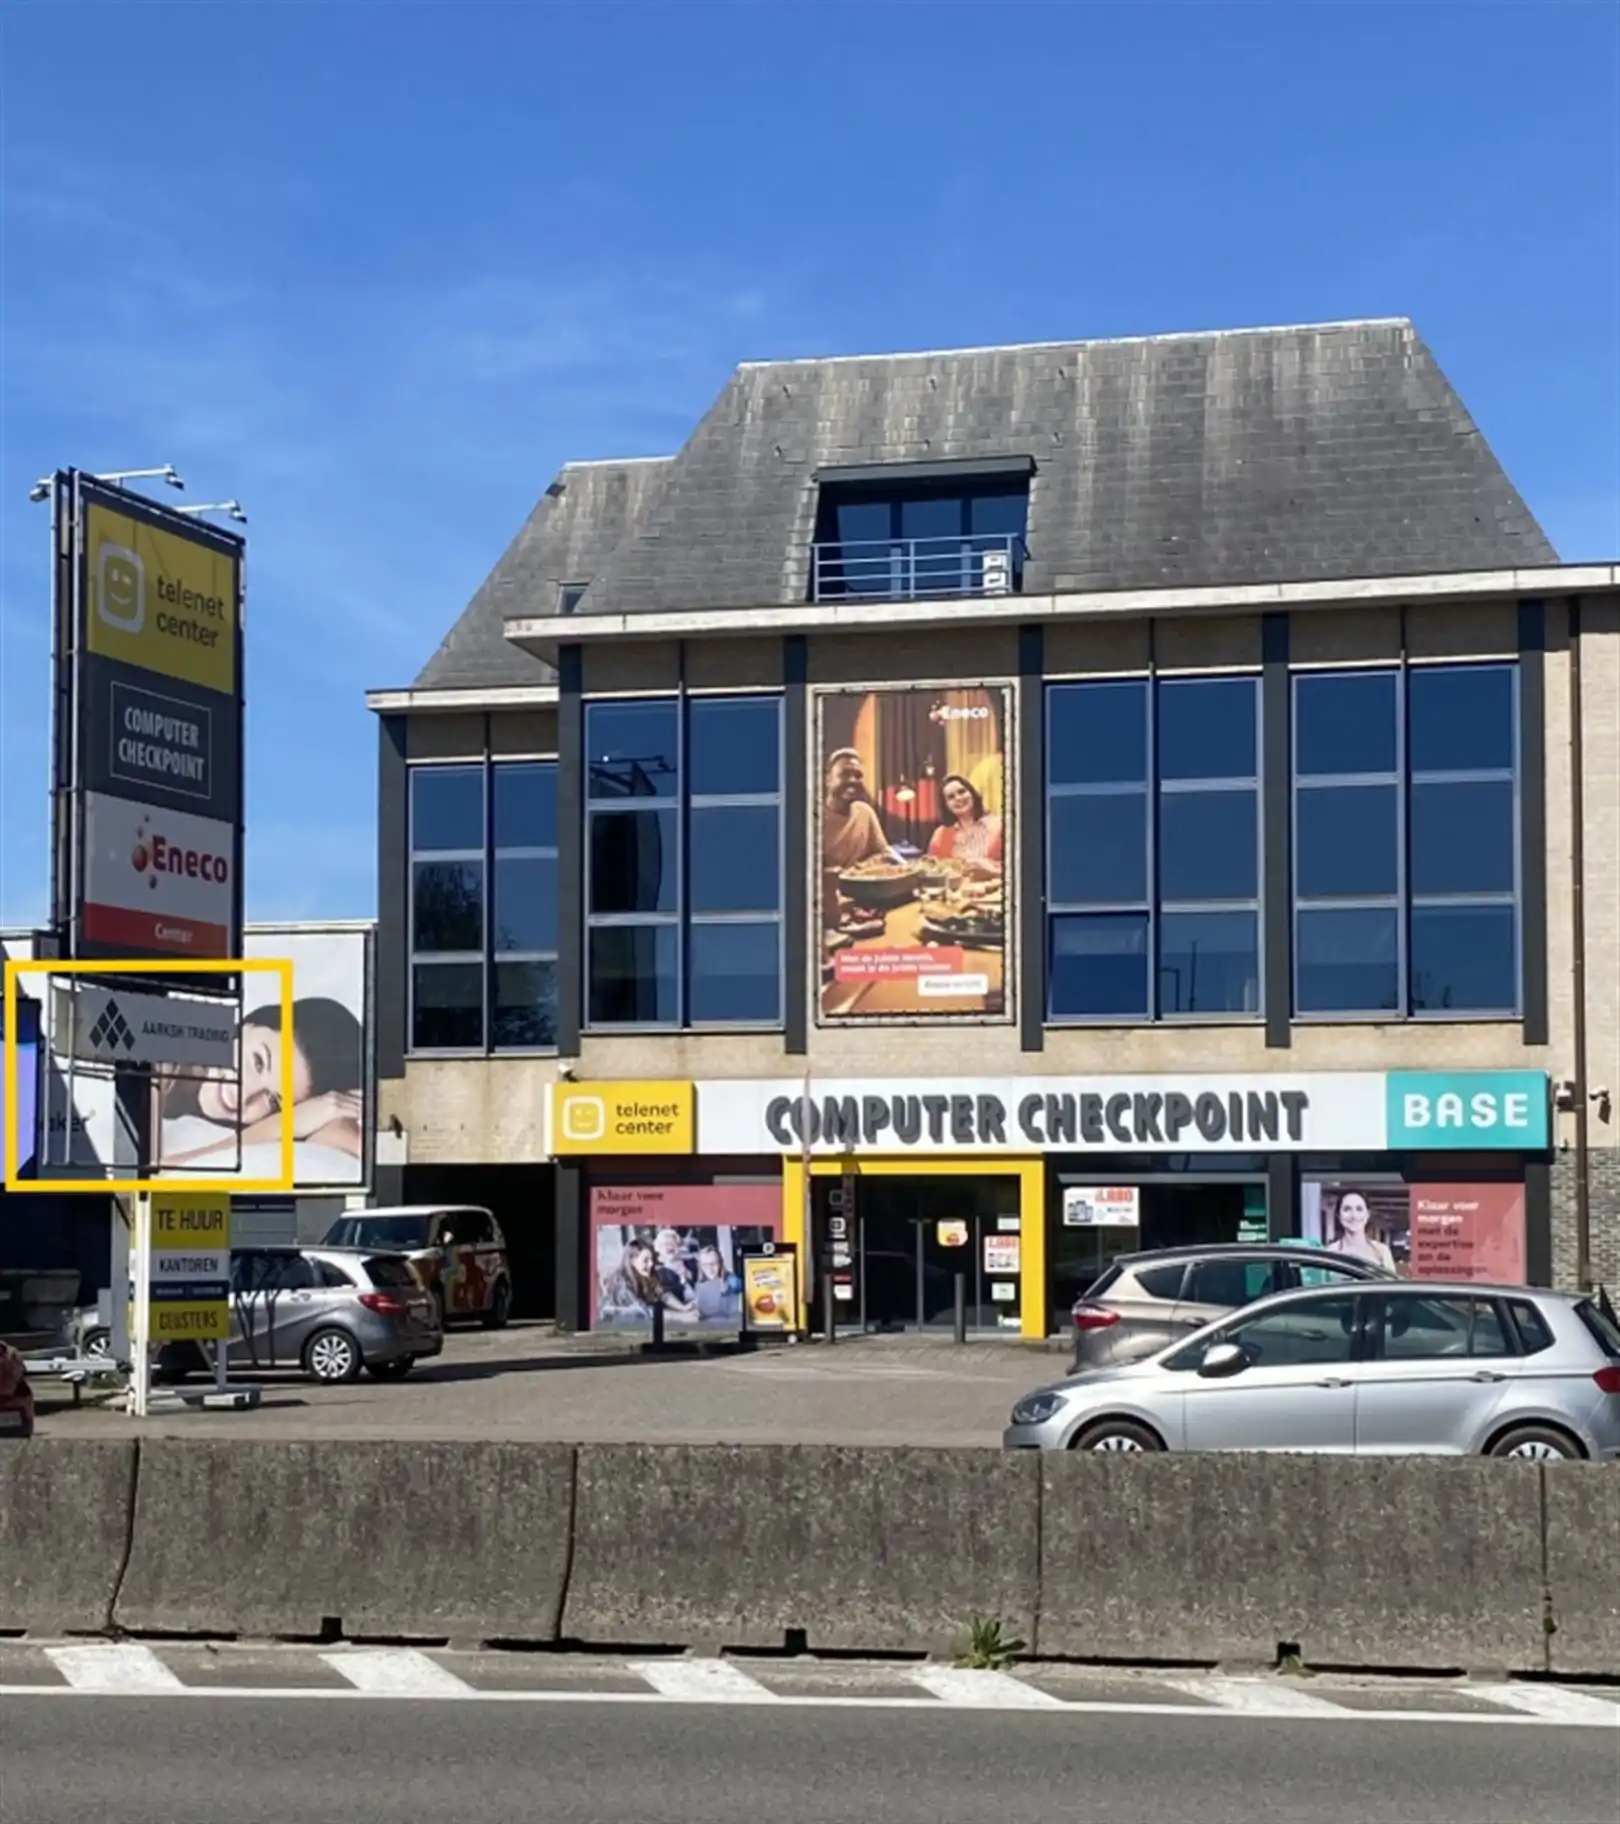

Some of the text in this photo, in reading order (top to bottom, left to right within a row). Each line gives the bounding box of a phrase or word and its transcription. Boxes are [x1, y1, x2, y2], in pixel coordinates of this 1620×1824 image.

[157, 575, 224, 620] telenet
[156, 612, 218, 648] center
[124, 707, 199, 747] COMPUTER
[118, 738, 204, 781] CHECKPOINT
[152, 834, 228, 884] Eneco
[154, 922, 193, 944] Center
[615, 1120, 674, 1135] center
[616, 1102, 679, 1117] telenet
[765, 1090, 1309, 1145] COMPUTER CHECKPOINT
[1404, 1092, 1529, 1128] BASE
[157, 1209, 223, 1230] TE HUUR
[159, 1258, 218, 1273] KANTOREN
